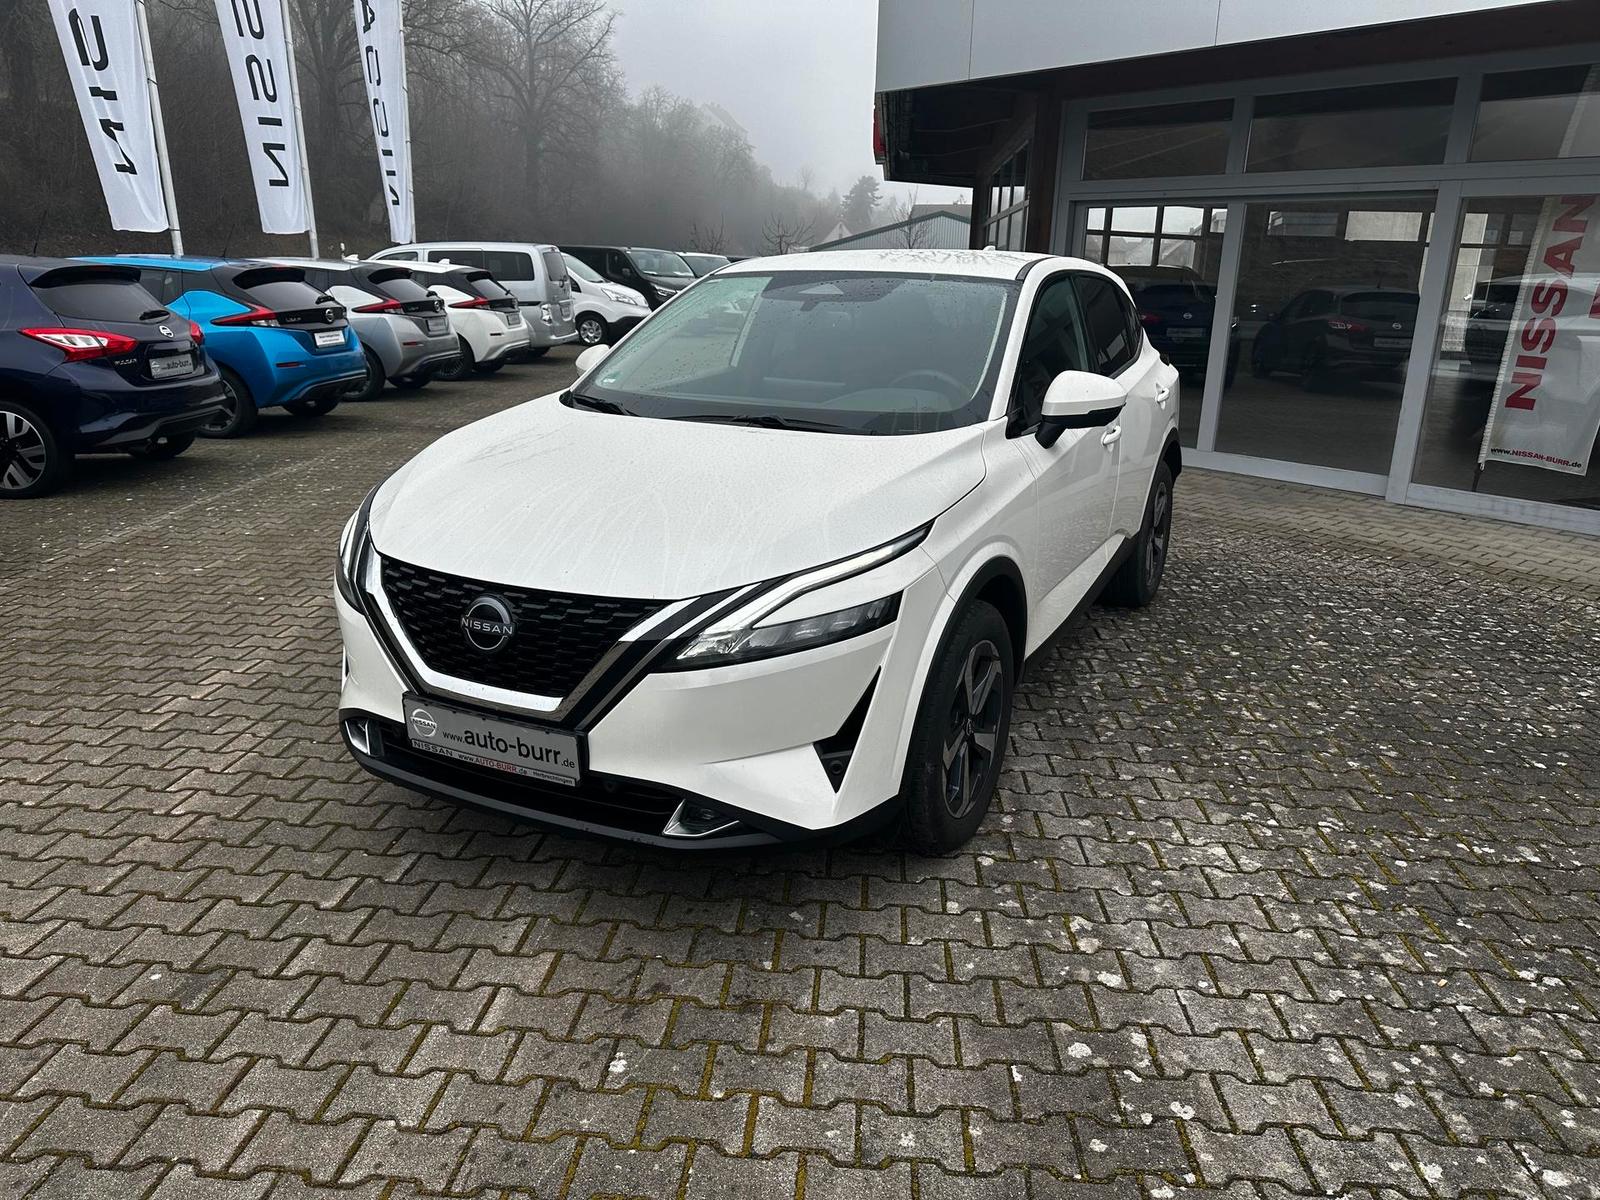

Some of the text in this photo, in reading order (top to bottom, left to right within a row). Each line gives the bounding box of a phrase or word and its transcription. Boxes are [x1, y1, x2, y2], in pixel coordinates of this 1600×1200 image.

[1505, 194, 1595, 411] NISSAN
[1490, 447, 1582, 469] www.NISSAN-BURR.de
[461, 617, 513, 635] NISSAN
[412, 718, 437, 729] NISSAN
[413, 741, 453, 757] NISSAN
